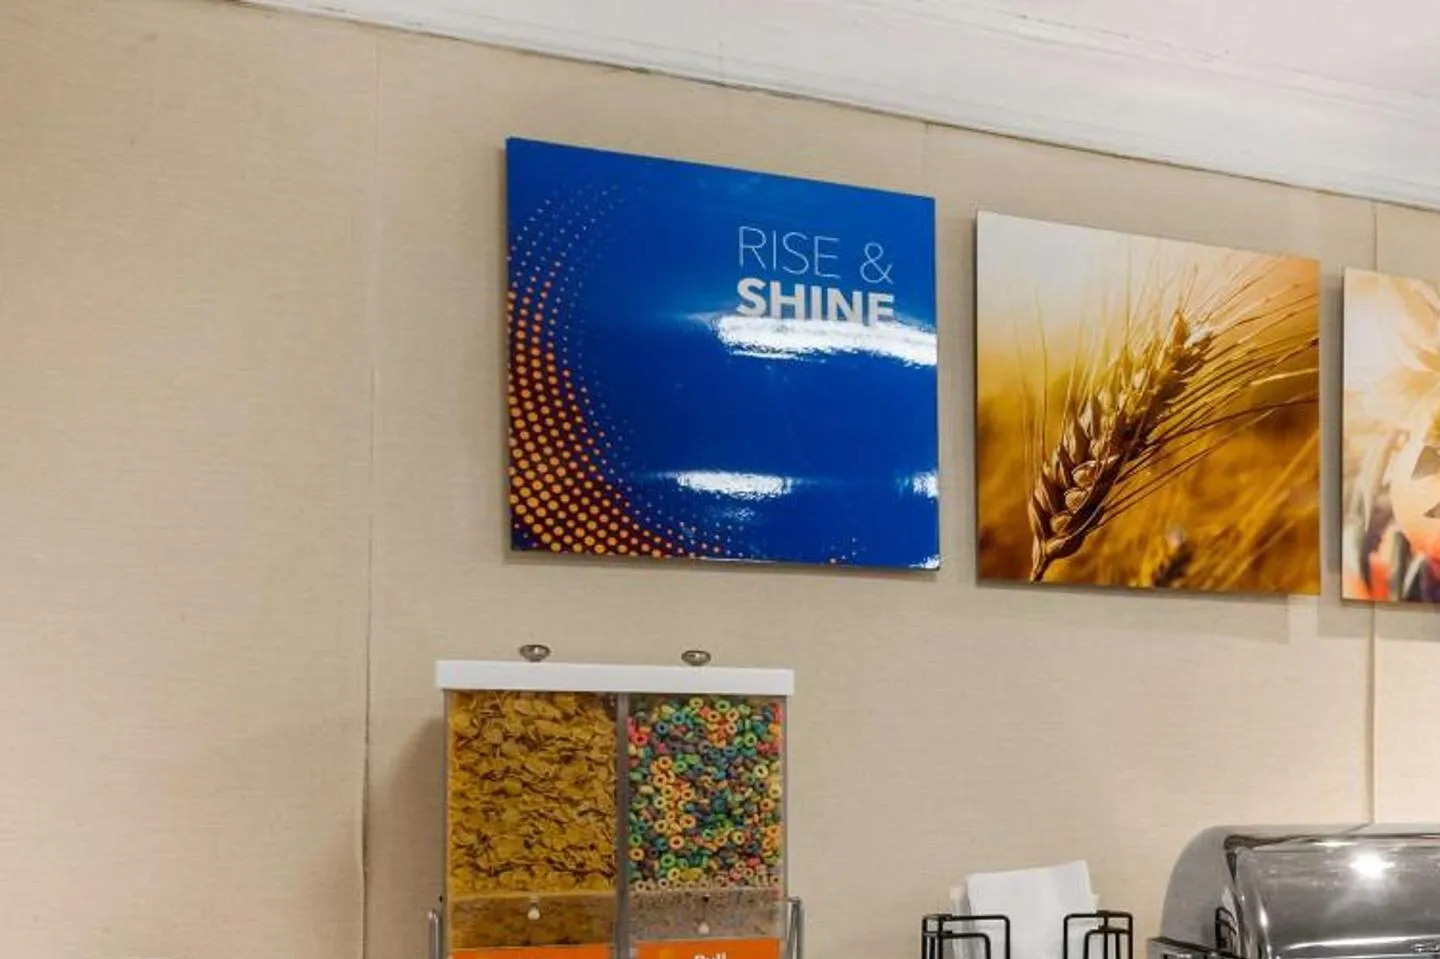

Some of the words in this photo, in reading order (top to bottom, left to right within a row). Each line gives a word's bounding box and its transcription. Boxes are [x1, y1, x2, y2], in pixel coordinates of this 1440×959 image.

[738, 225, 841, 280] RISE
[859, 242, 896, 285] &
[735, 276, 896, 328] SHINE
